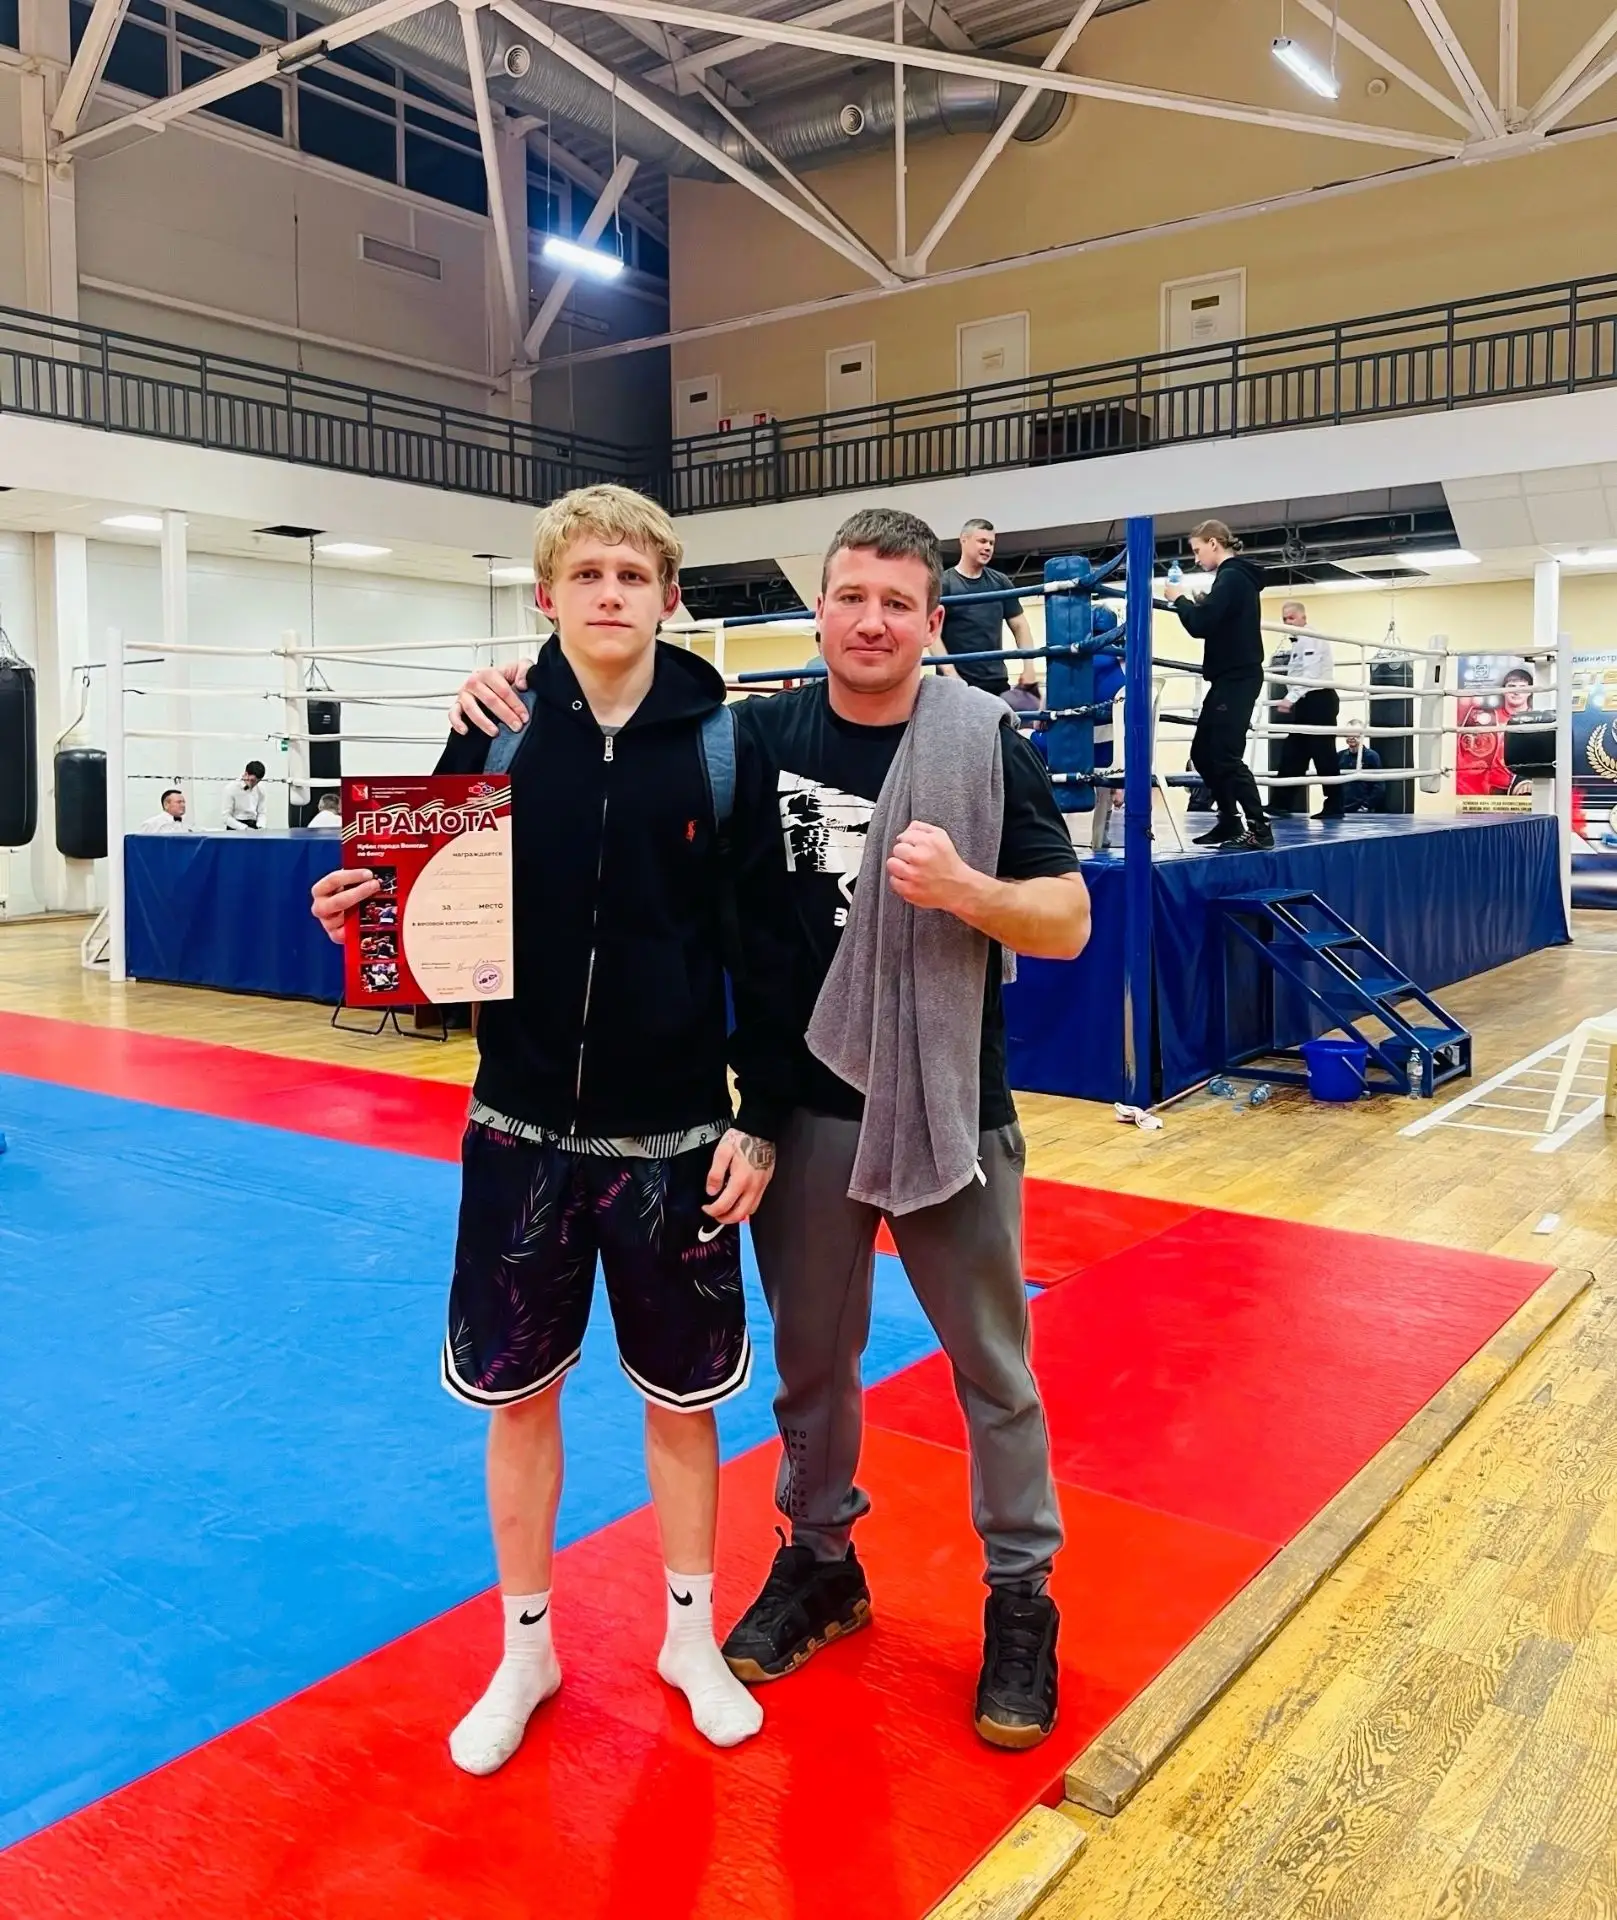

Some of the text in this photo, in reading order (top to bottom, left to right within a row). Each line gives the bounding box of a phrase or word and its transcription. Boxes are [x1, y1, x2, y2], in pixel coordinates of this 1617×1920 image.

[356, 810, 499, 835] ГРАМОТА
[452, 851, 503, 859] награждается
[478, 902, 504, 910] место
